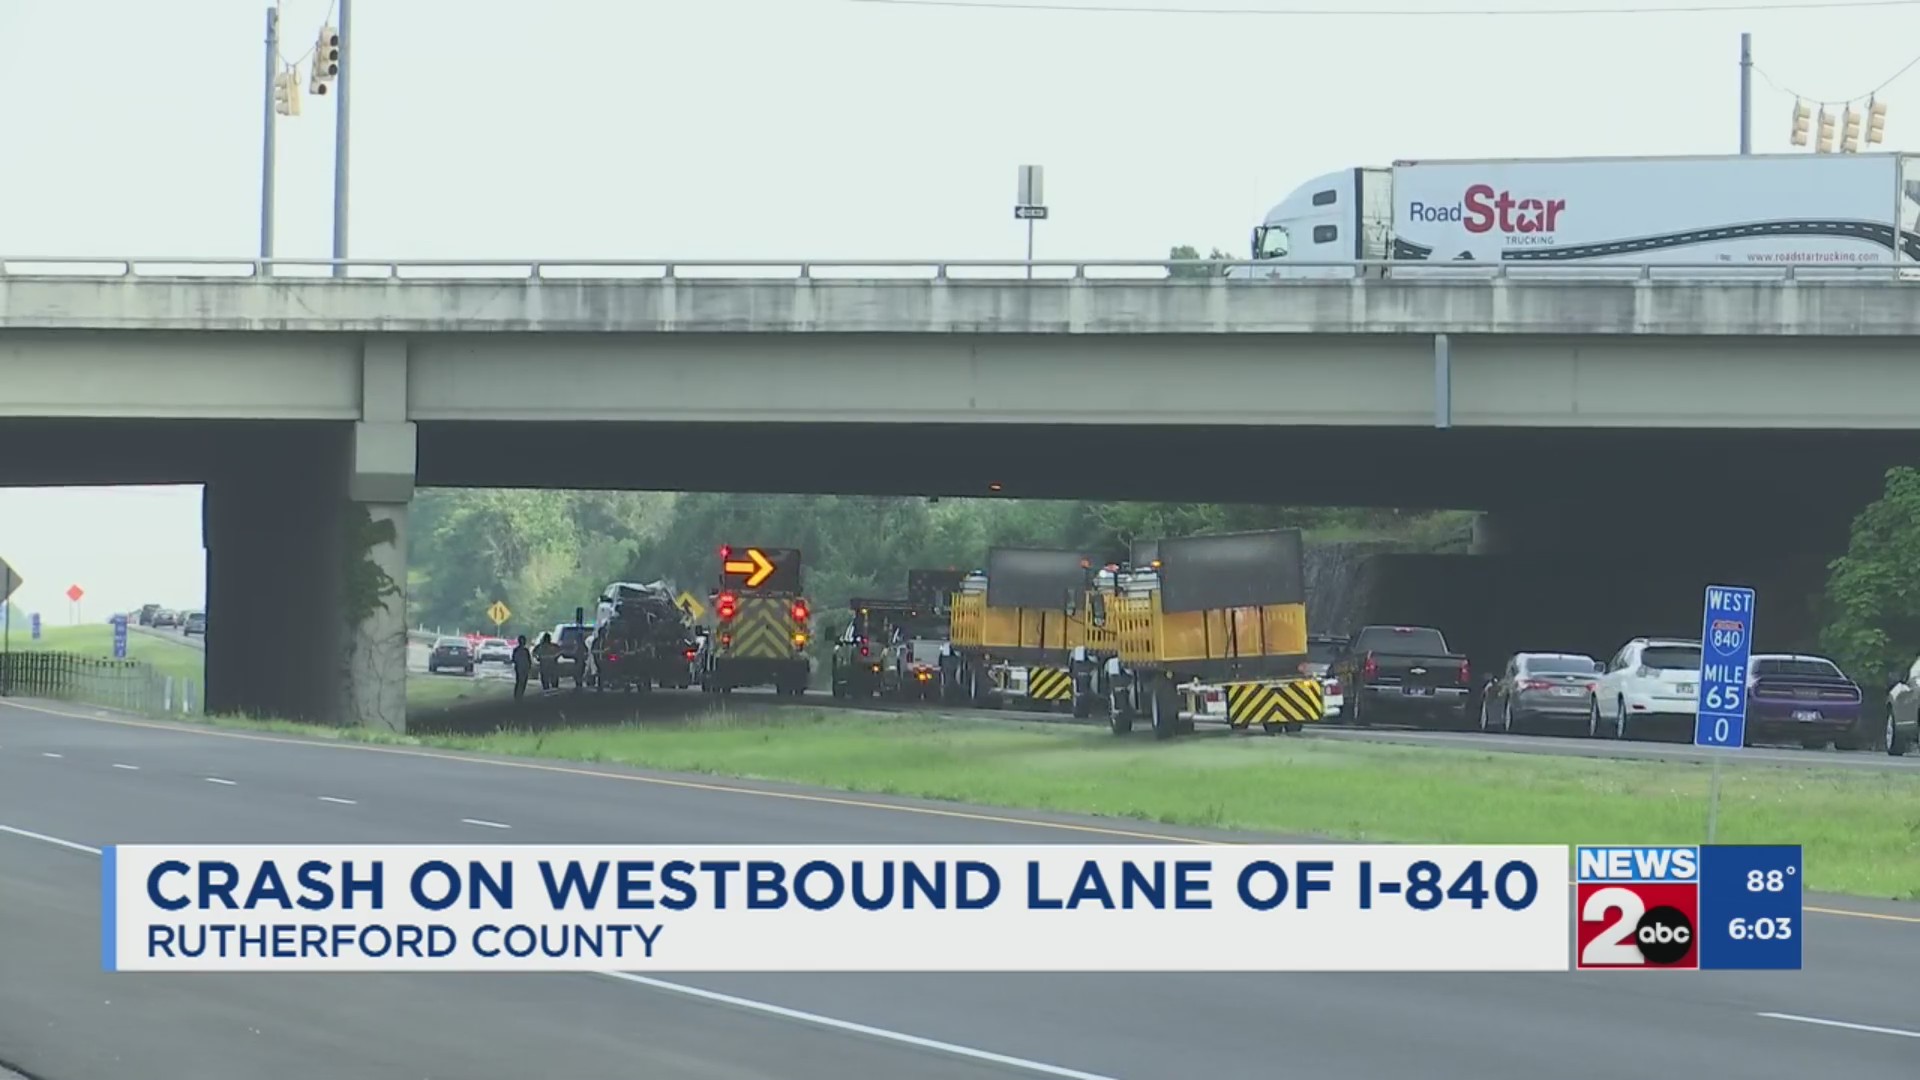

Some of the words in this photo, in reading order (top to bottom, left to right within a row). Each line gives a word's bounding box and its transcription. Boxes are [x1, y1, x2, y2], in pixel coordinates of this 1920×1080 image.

[1505, 236, 1555, 245] TRUCKING
[1747, 252, 1879, 262] www.roadstartrucking.com
[1709, 590, 1751, 612] WEST
[1714, 630, 1740, 648] 840
[1704, 664, 1744, 684] MILE
[1706, 686, 1740, 710] 65
